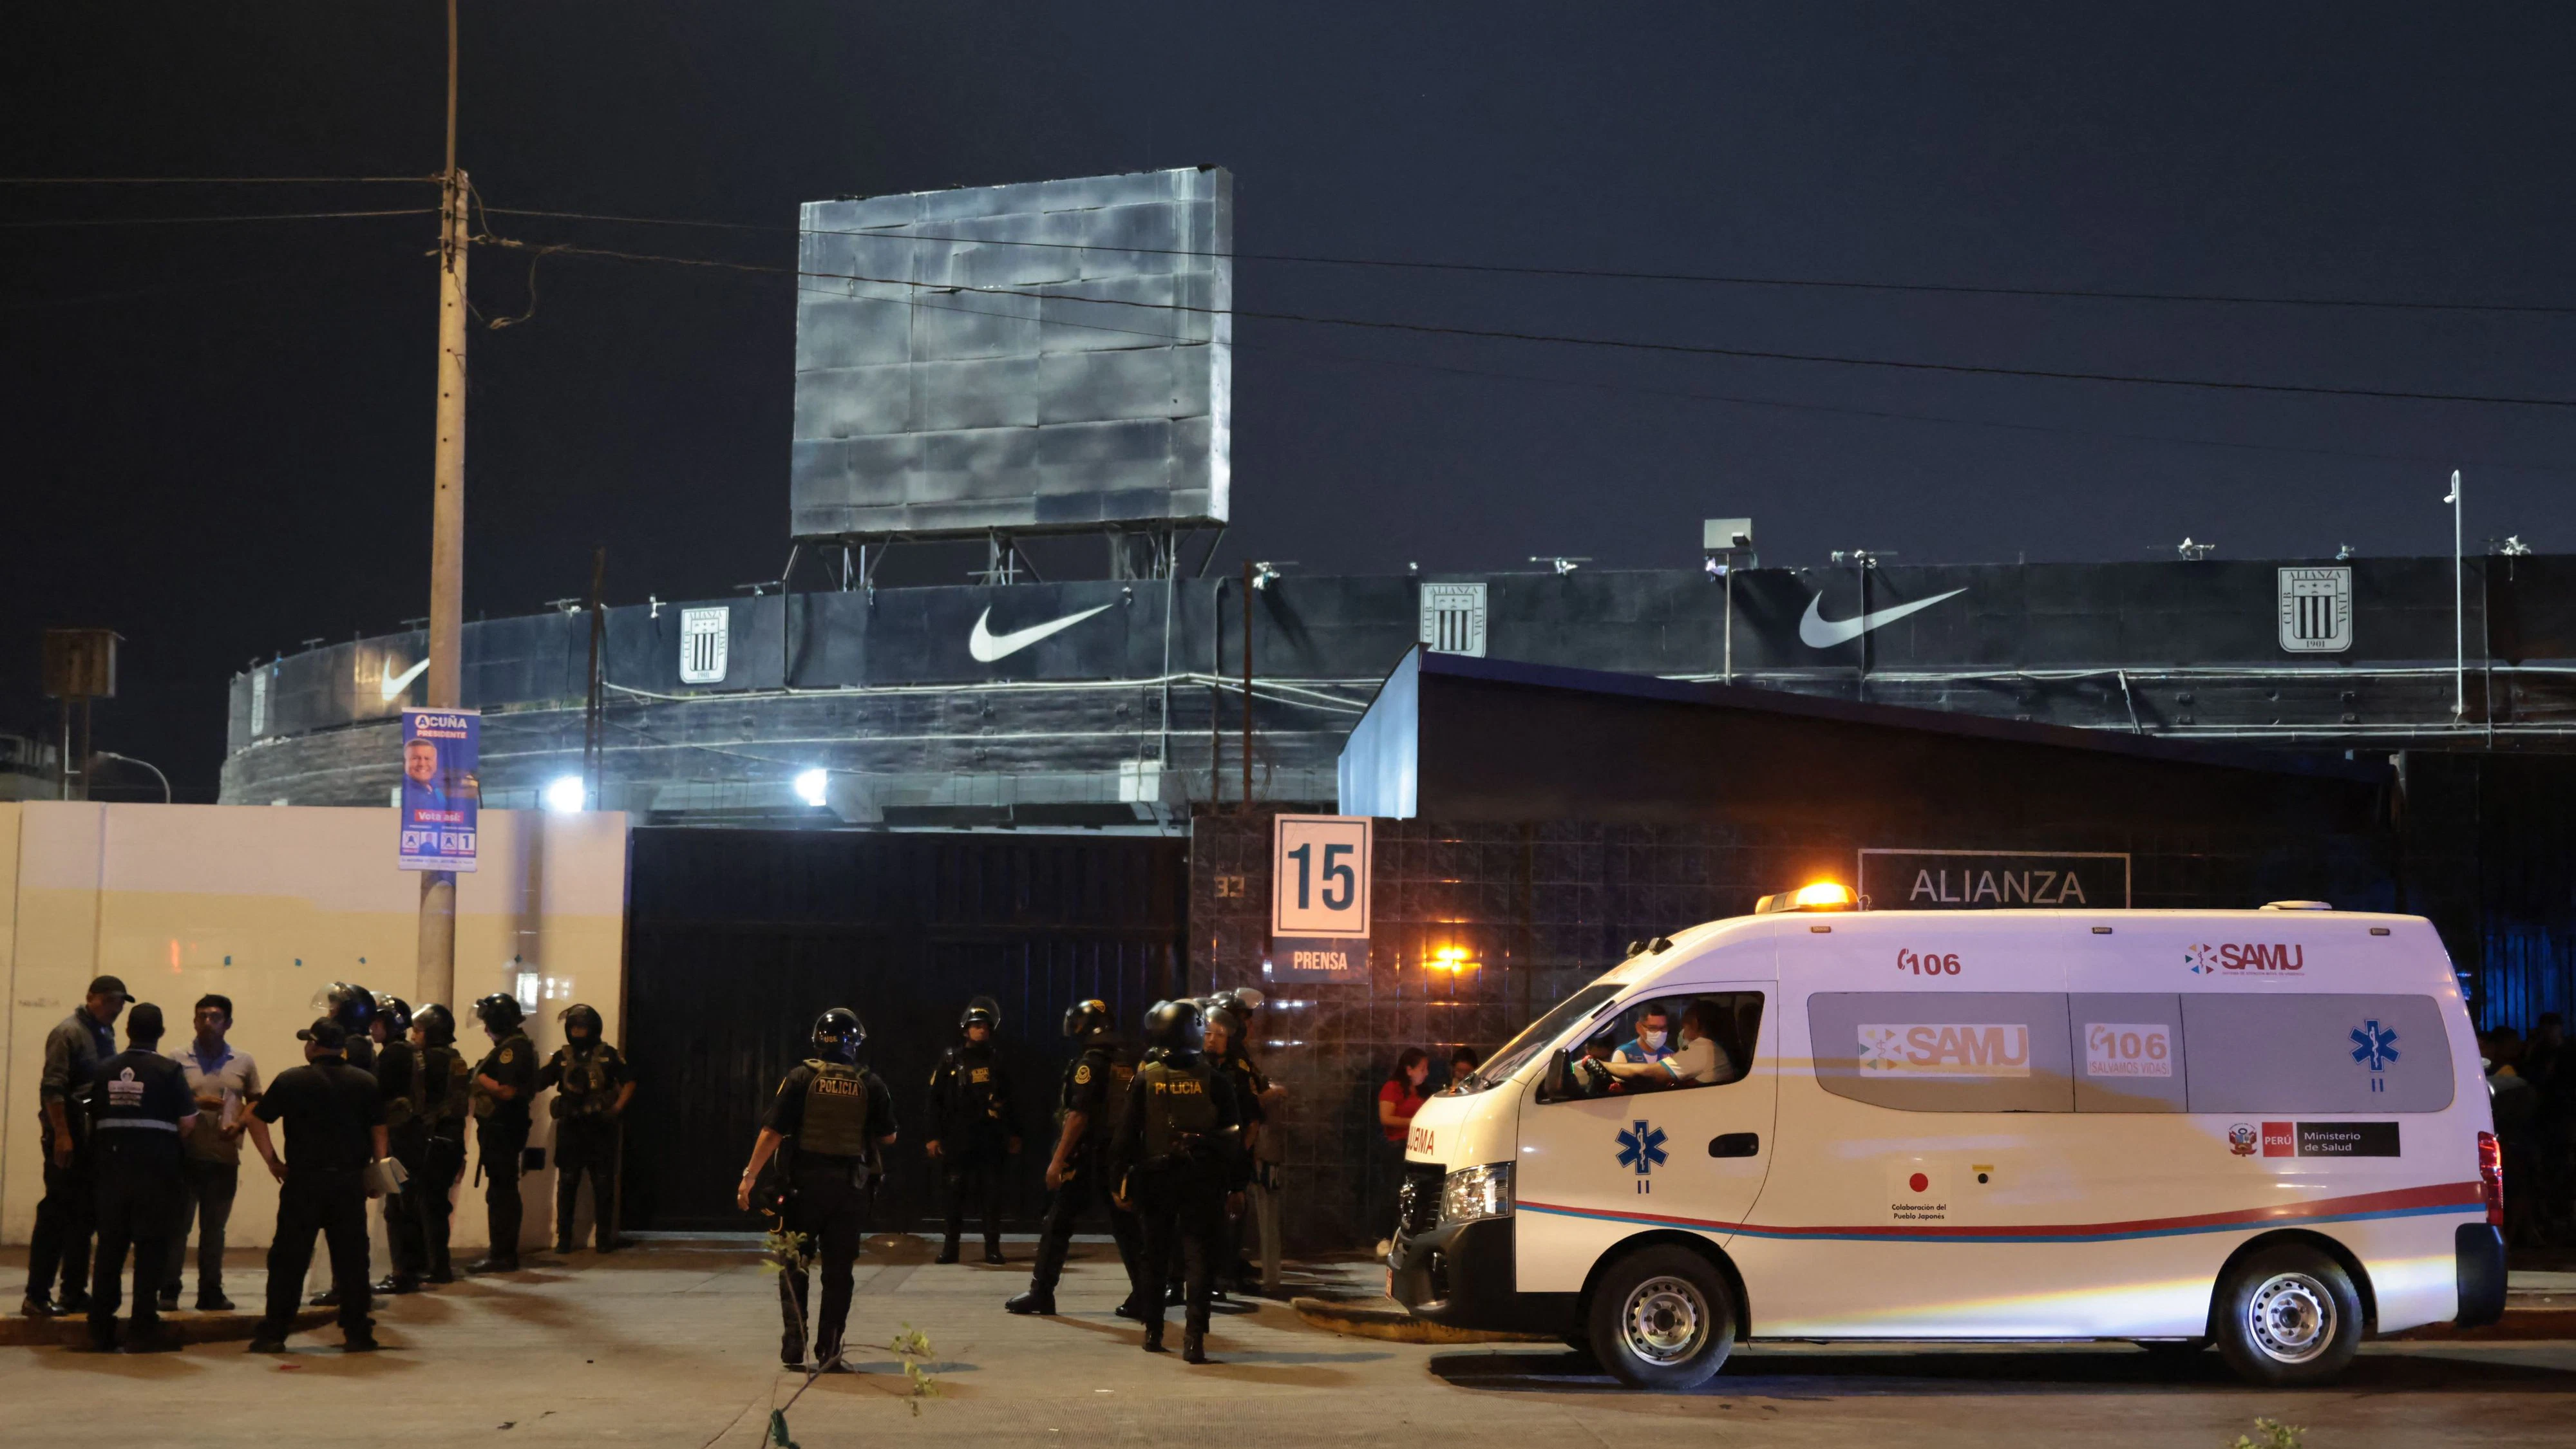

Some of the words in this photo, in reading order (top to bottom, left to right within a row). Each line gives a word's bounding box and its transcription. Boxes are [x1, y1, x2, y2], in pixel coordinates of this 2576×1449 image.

[2289, 571, 2341, 579] ALIANZA
[2283, 592, 2291, 624] CLUB
[2338, 592, 2347, 623] LIMA
[415, 715, 468, 729] ACUÑA
[417, 730, 466, 739] PRESIDENTE
[419, 811, 442, 820] Vota
[463, 835, 469, 849] 1
[1288, 843, 1355, 911] 15
[1909, 869, 2086, 904] ALIANZA
[1294, 951, 1347, 970] PRENSA
[1907, 953, 1961, 976] 106
[2220, 943, 2303, 971] SAMU
[1906, 1027, 2028, 1066] SAMU
[2101, 1032, 2167, 1059] 106
[819, 1079, 858, 1096] POLICIA
[2265, 1134, 2291, 1145] PERÚ
[2304, 1132, 2361, 1141] Ministerio
[2322, 1143, 2352, 1151] Salud
[1918, 1213, 1944, 1221] Japonés
